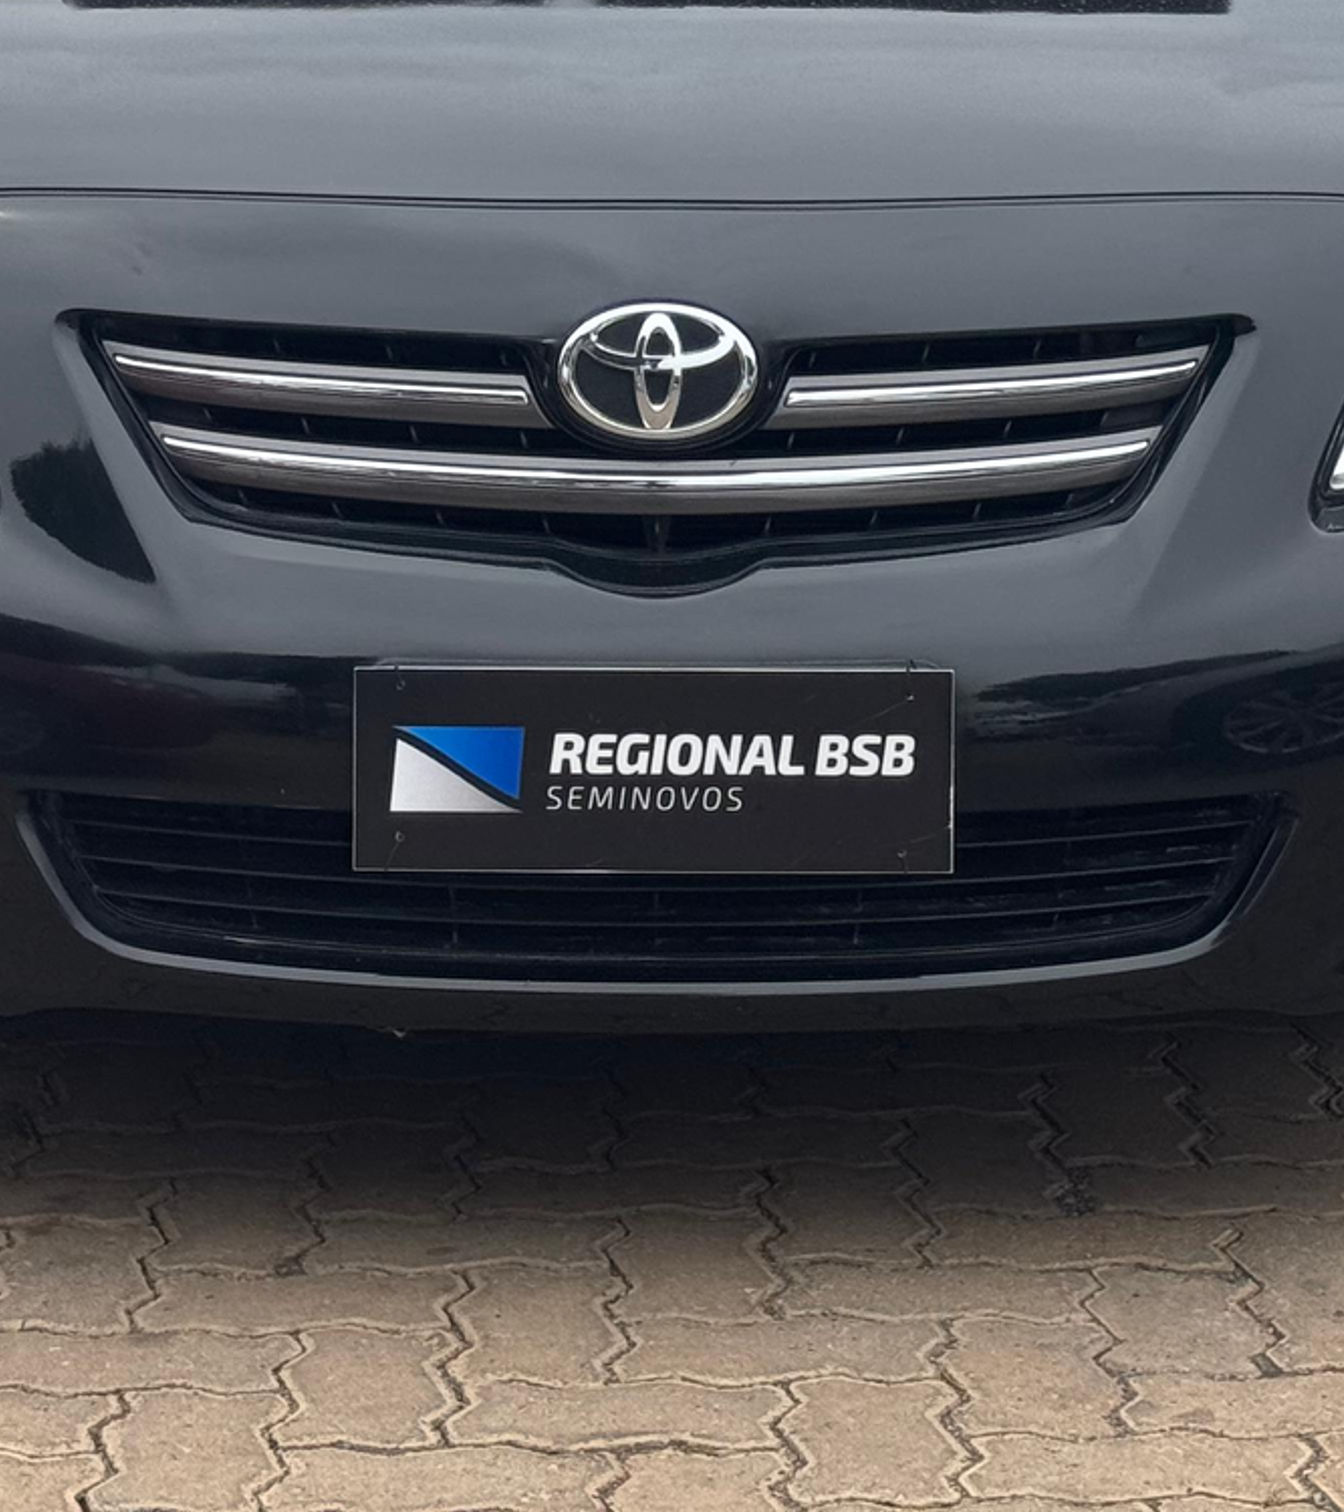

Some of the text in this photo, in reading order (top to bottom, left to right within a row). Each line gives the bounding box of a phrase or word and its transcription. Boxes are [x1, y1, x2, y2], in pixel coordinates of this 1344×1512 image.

[549, 732, 916, 777] REGIONAL BSB
[545, 785, 744, 812] SEMINOVOS
